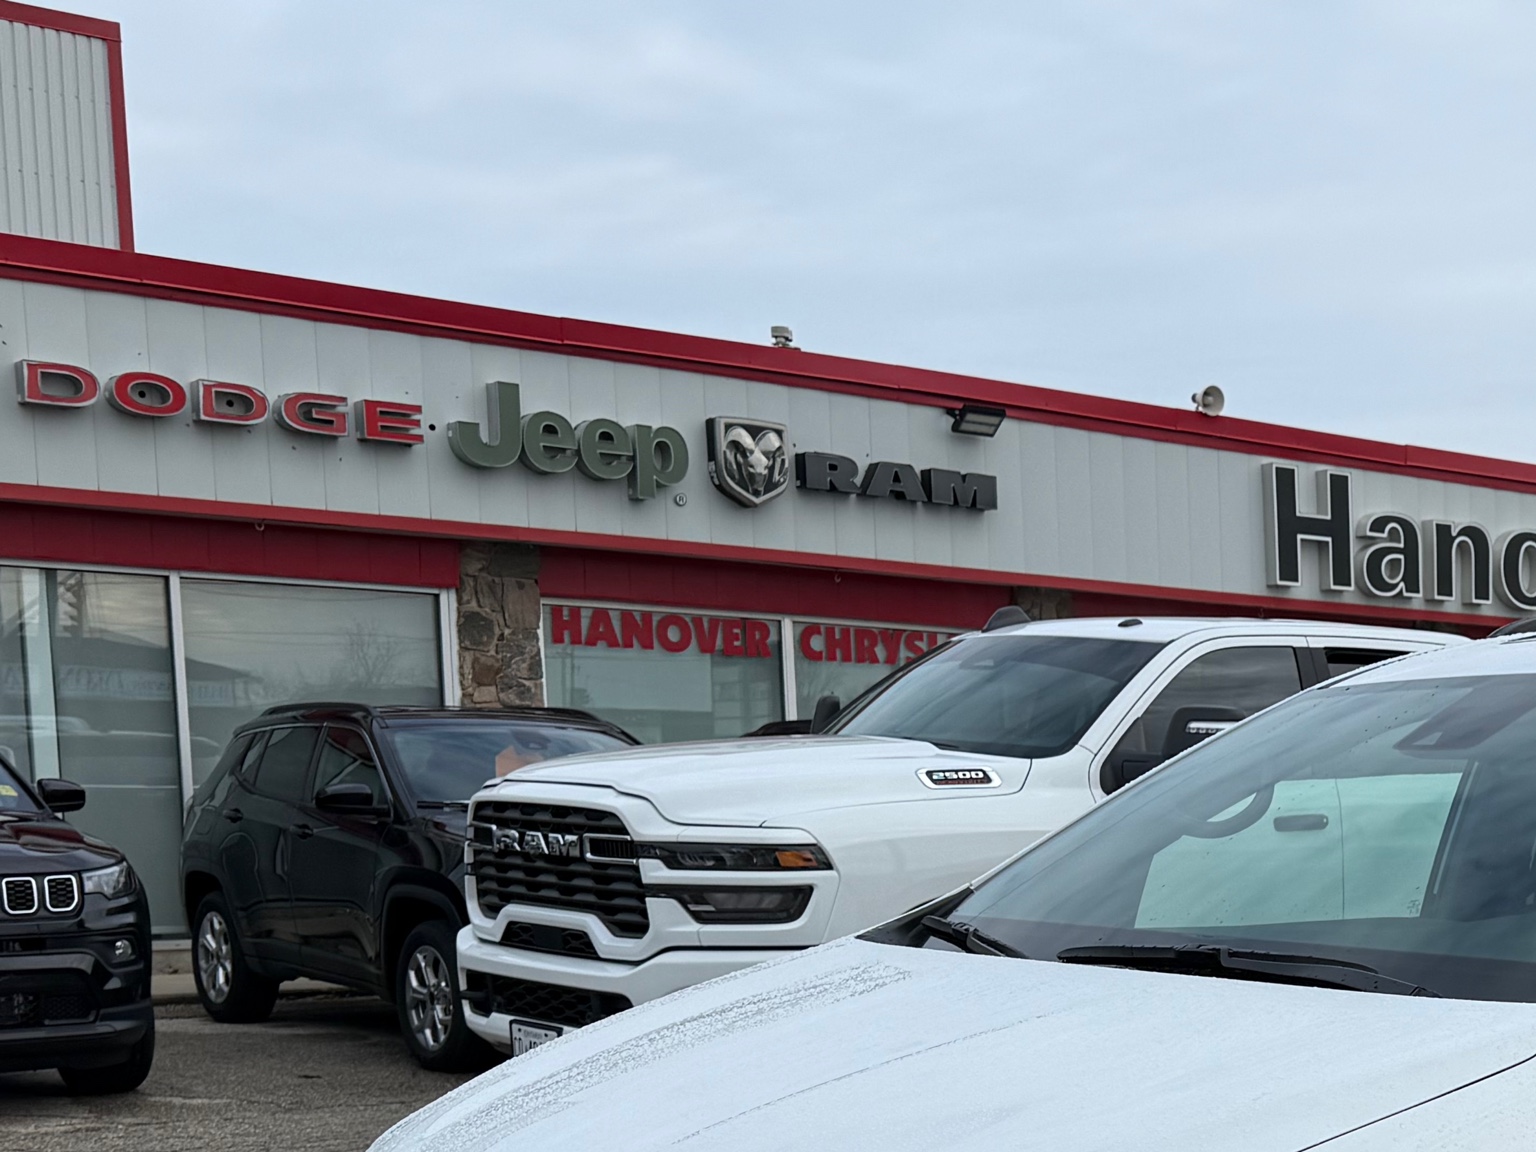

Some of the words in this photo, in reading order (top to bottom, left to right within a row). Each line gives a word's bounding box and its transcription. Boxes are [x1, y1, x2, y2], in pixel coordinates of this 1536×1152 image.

[16, 359, 425, 446] DODGE
[447, 381, 689, 500] Jeep
[795, 451, 998, 511] RAM
[550, 606, 772, 659] HANOVER
[799, 624, 954, 666] CHRYS
[932, 770, 985, 780] 2500
[492, 827, 580, 858] RAM
